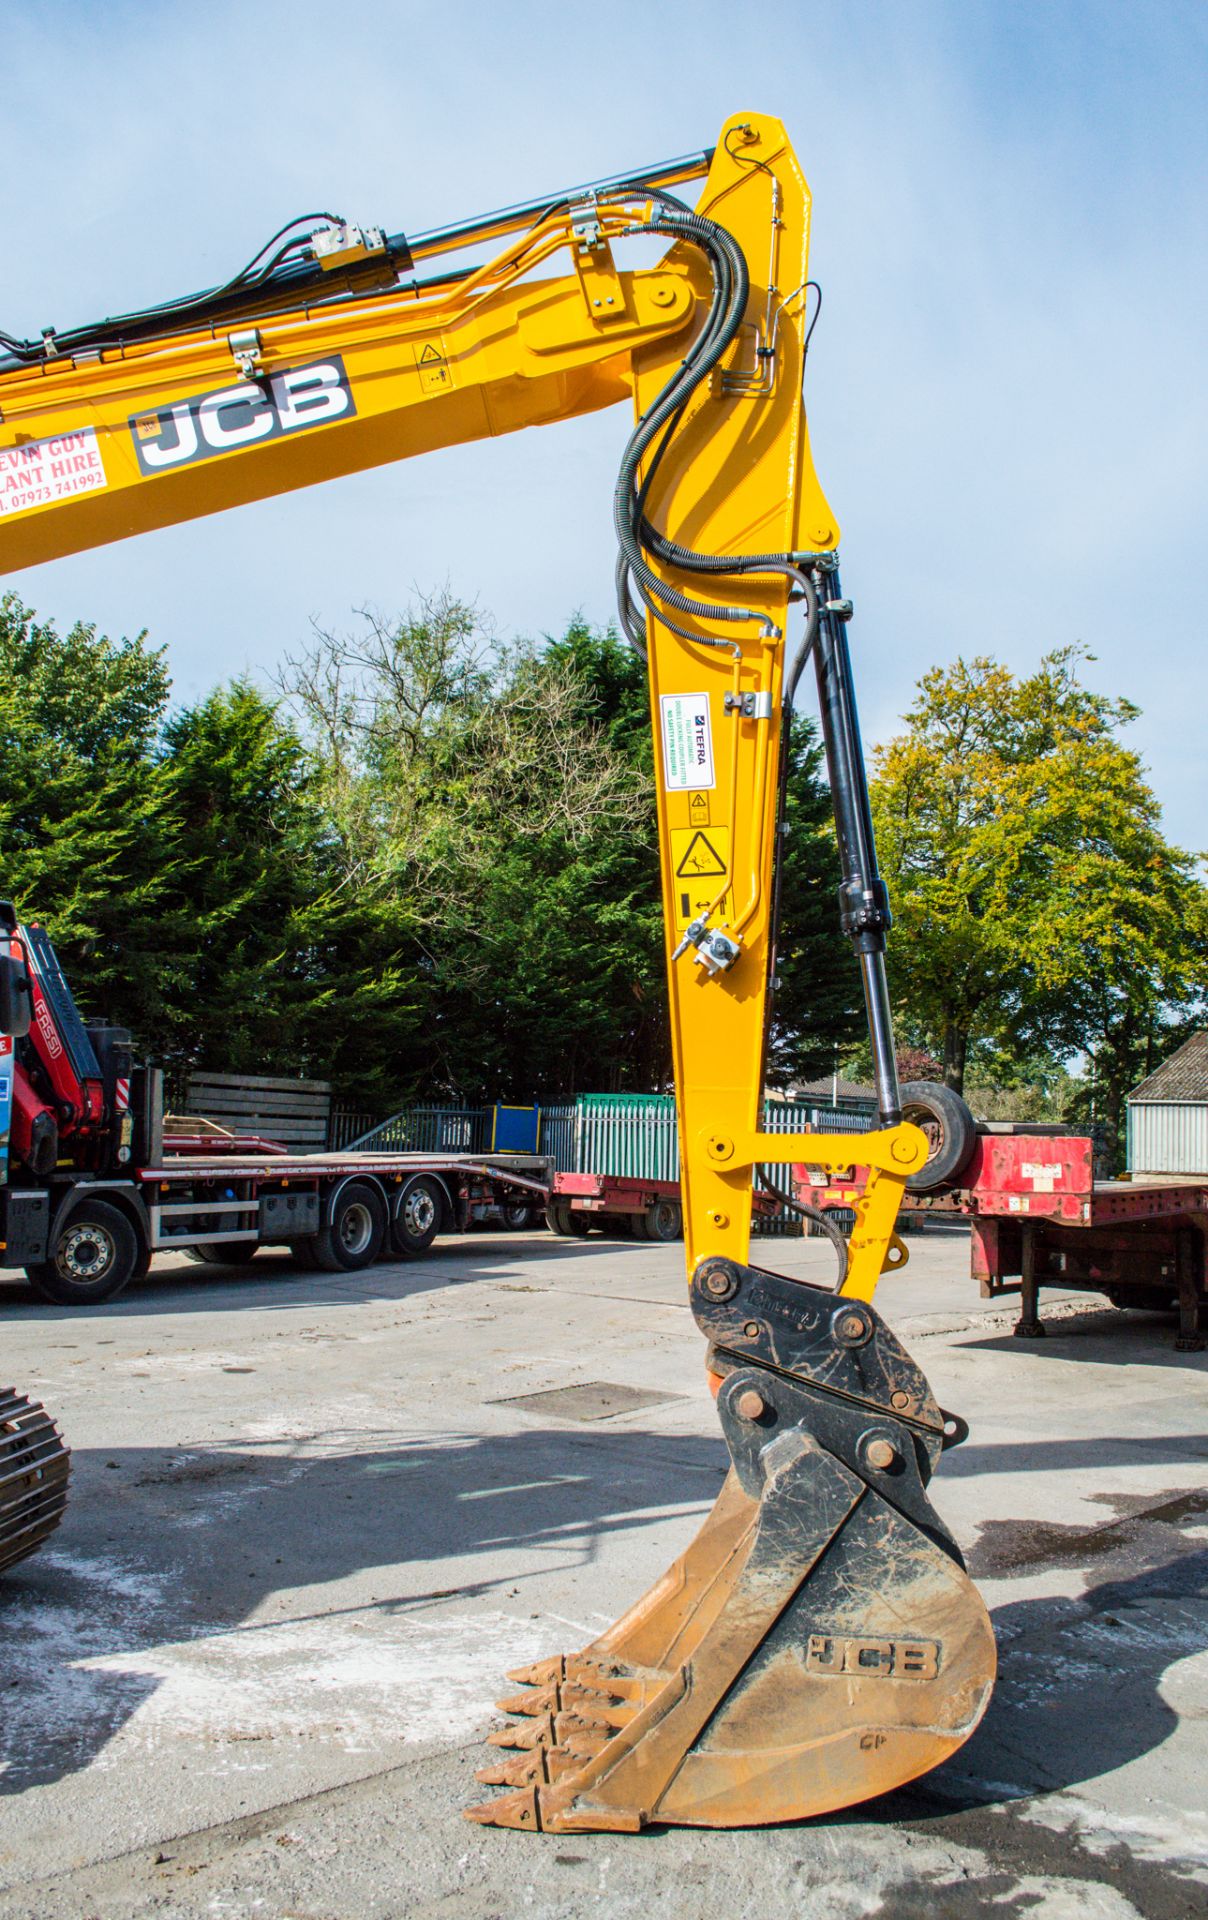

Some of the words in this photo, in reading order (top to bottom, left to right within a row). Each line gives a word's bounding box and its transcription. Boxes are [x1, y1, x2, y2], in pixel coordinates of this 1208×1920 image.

[141, 364, 349, 466] JCB
[48, 432, 85, 456] GUY
[50, 451, 99, 478] HIRE
[12, 487, 51, 507] 07973
[56, 472, 103, 495] 741992
[670, 749, 678, 776] REQUIRED
[695, 728, 706, 765] TEFRA
[35, 1004, 60, 1054] FASSI
